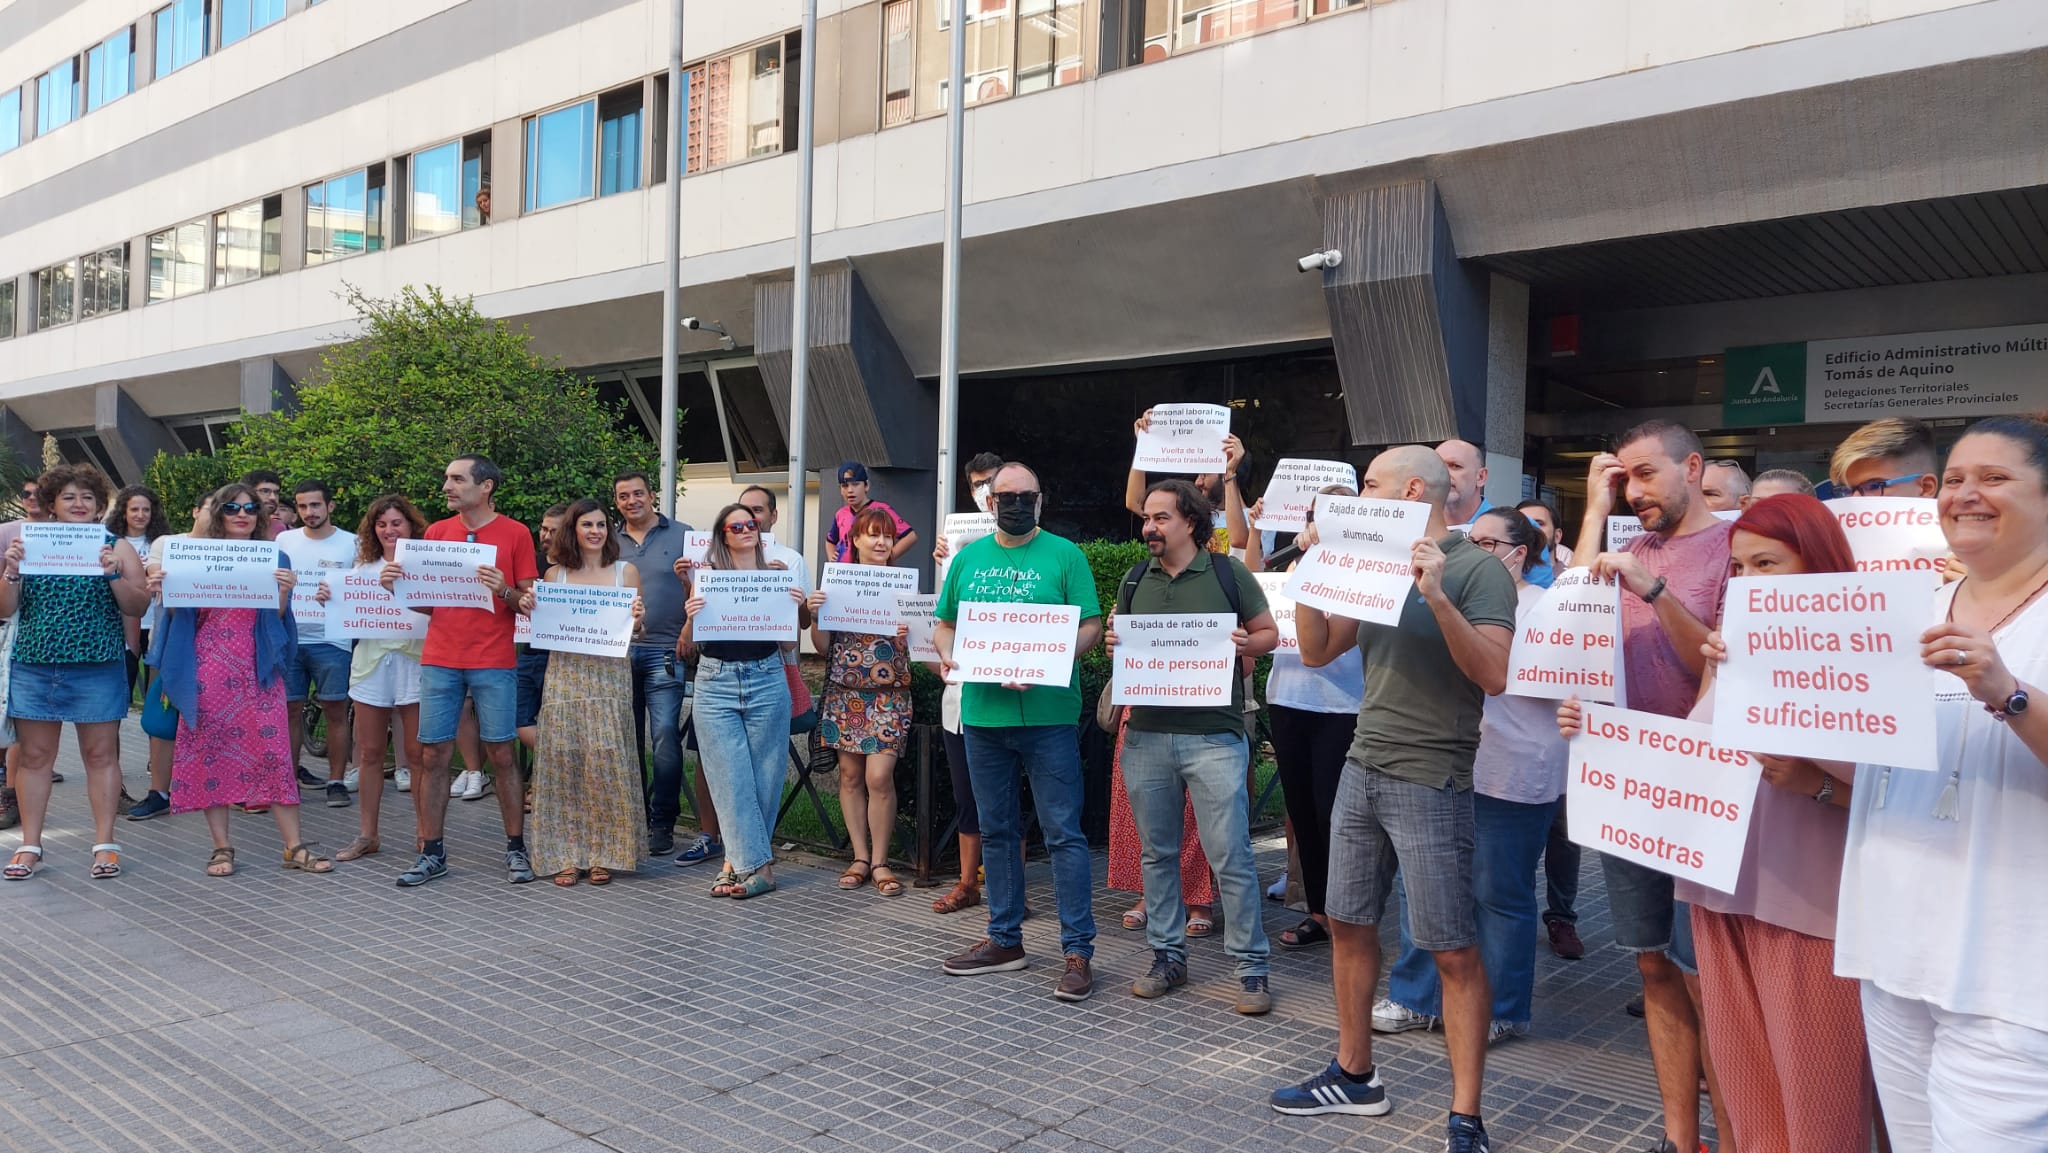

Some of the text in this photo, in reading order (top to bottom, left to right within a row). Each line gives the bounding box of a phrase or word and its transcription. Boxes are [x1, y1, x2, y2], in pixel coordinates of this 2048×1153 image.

[1825, 350, 1880, 365] Edificio
[1884, 342, 2001, 361] Administrativo
[1824, 362, 1954, 381] Tomás de Aquino
[1824, 381, 1969, 400] Delegaciones Territoriales
[1732, 394, 1799, 406] Junta de Andalucía
[1824, 392, 2019, 411] Secretarías Generales Provinciales
[1185, 407, 1213, 416] laboral
[1214, 409, 1225, 417] no
[1169, 417, 1225, 428] trapos de usar
[1171, 427, 1194, 437] y tirar
[1161, 446, 1204, 454] Vuelta de la
[1313, 463, 1344, 473] laboral
[1293, 473, 1333, 483] trapos de
[1295, 484, 1321, 493] y tirar
[1283, 503, 1310, 512] Vuelta
[1329, 502, 1405, 519] Bajada de ratio de
[1261, 513, 1306, 522] compañera
[33, 525, 65, 533] personal
[1612, 521, 1620, 531] El
[1342, 528, 1384, 543] alumnado
[170, 542, 180, 550] El
[182, 543, 224, 552] personal
[226, 544, 258, 553] laboral
[405, 543, 433, 554] Bajada
[447, 546, 468, 554] ratio
[169, 553, 202, 561] somos
[204, 554, 234, 563] trapos
[236, 554, 248, 562] de
[421, 560, 463, 568] alumnado
[1317, 549, 1413, 577] No de personal
[214, 563, 234, 572] tirar
[827, 567, 835, 575] El
[836, 568, 872, 579] personal
[873, 570, 901, 580] laboral
[402, 572, 437, 582] No de
[700, 575, 709, 583] El
[710, 575, 749, 585] personal
[750, 575, 780, 583] laboral
[1582, 573, 1600, 586] de
[192, 582, 248, 591] Vuelta de la
[826, 577, 913, 590] somos trapos de usar
[168, 591, 273, 600] compañera trasladada
[344, 590, 391, 602] pública
[537, 585, 633, 599] El personal laboral no
[700, 585, 772, 595] somos trapos de
[863, 589, 881, 598] tirar
[1301, 579, 1396, 611] administrativo
[406, 591, 489, 603] administrativo
[569, 597, 597, 607] trapos
[599, 598, 610, 607] de
[612, 601, 632, 609] usar
[733, 594, 760, 604] y tirar
[1748, 585, 1887, 613] Educación
[897, 599, 934, 608] El personal
[355, 605, 402, 616] medios
[571, 606, 598, 615] y tirar
[844, 606, 891, 617] Vuelta de la
[967, 607, 1071, 624] Los recortes
[721, 614, 771, 622] Vuelta de la
[823, 615, 868, 625] compañera
[343, 619, 413, 631] suficientes
[559, 623, 608, 636] Vuelta de la
[698, 624, 793, 633] compañera trasladada
[1130, 618, 1219, 631] Bajada de ratio de
[535, 632, 627, 648] compañera trasladada
[1151, 638, 1200, 648] alumnado
[1524, 627, 1545, 644] No
[1549, 627, 1575, 647] de
[1747, 625, 1893, 656] pública sin
[962, 637, 1067, 654] los pagamos
[1125, 656, 1228, 673] No de personal
[972, 666, 1046, 679] nosotras
[1772, 665, 1870, 693] medios
[1123, 683, 1222, 697] administrativo
[1746, 701, 1898, 735] suficientes
[1586, 712, 1631, 742] Los
[1580, 761, 1740, 822] los pagamos
[1600, 822, 1704, 870] nosotras
